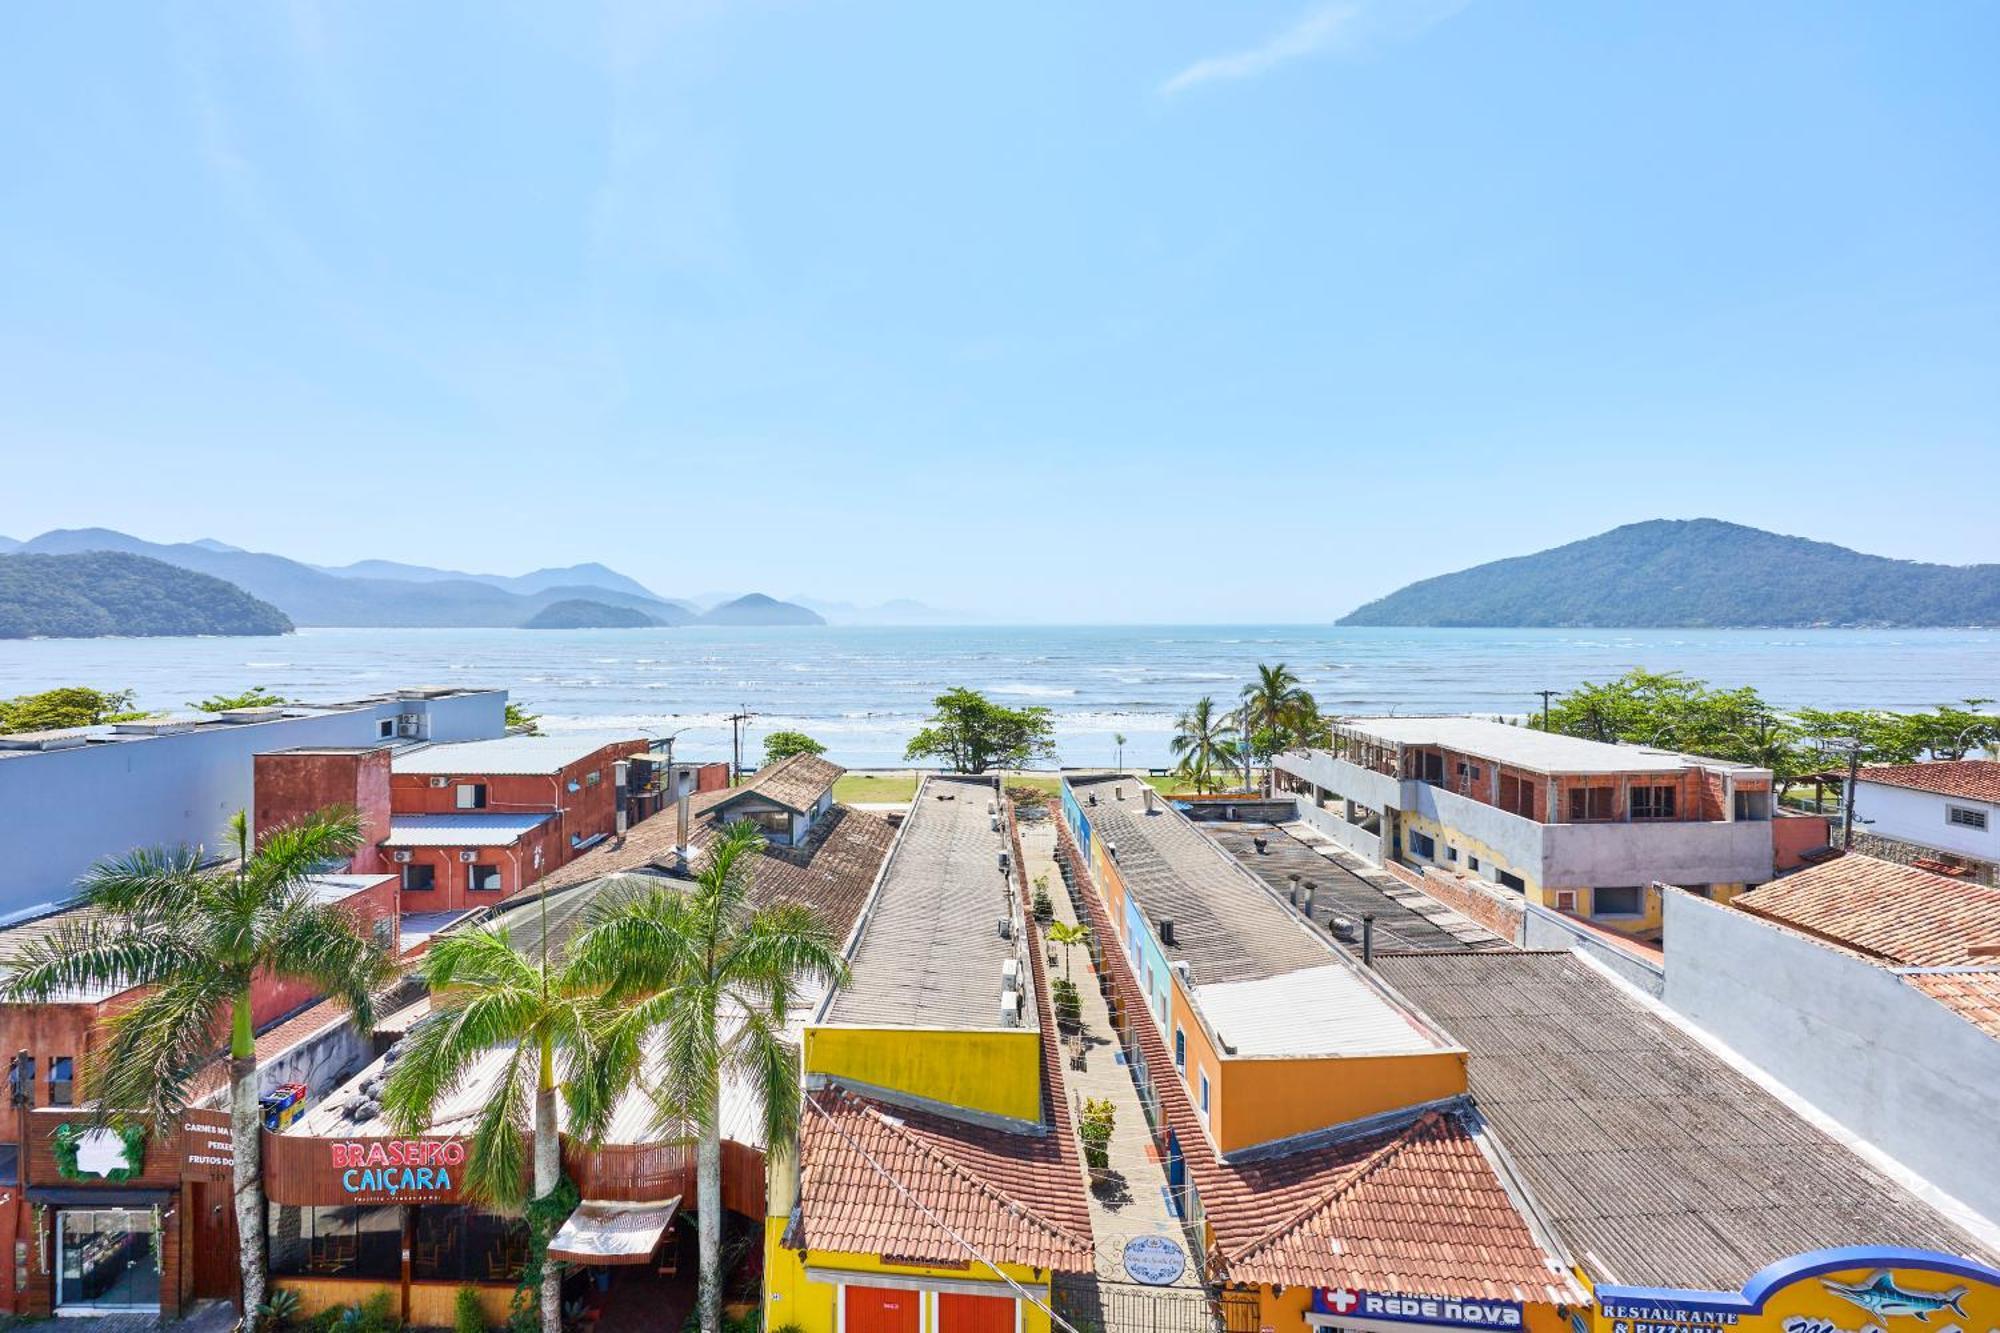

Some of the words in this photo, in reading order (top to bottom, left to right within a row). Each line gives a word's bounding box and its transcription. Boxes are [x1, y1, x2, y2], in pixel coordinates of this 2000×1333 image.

[184, 1123, 216, 1134] CARNES
[217, 1127, 229, 1136] NA
[189, 1155, 222, 1165] FRUTOS
[331, 1140, 465, 1169] BRASEIRO
[343, 1167, 452, 1196] CAIÇARA
[1366, 1297, 1438, 1317] REDE
[1603, 1305, 1738, 1325] RESTAURANTE
[1635, 1324, 1724, 1333] PIZZA
